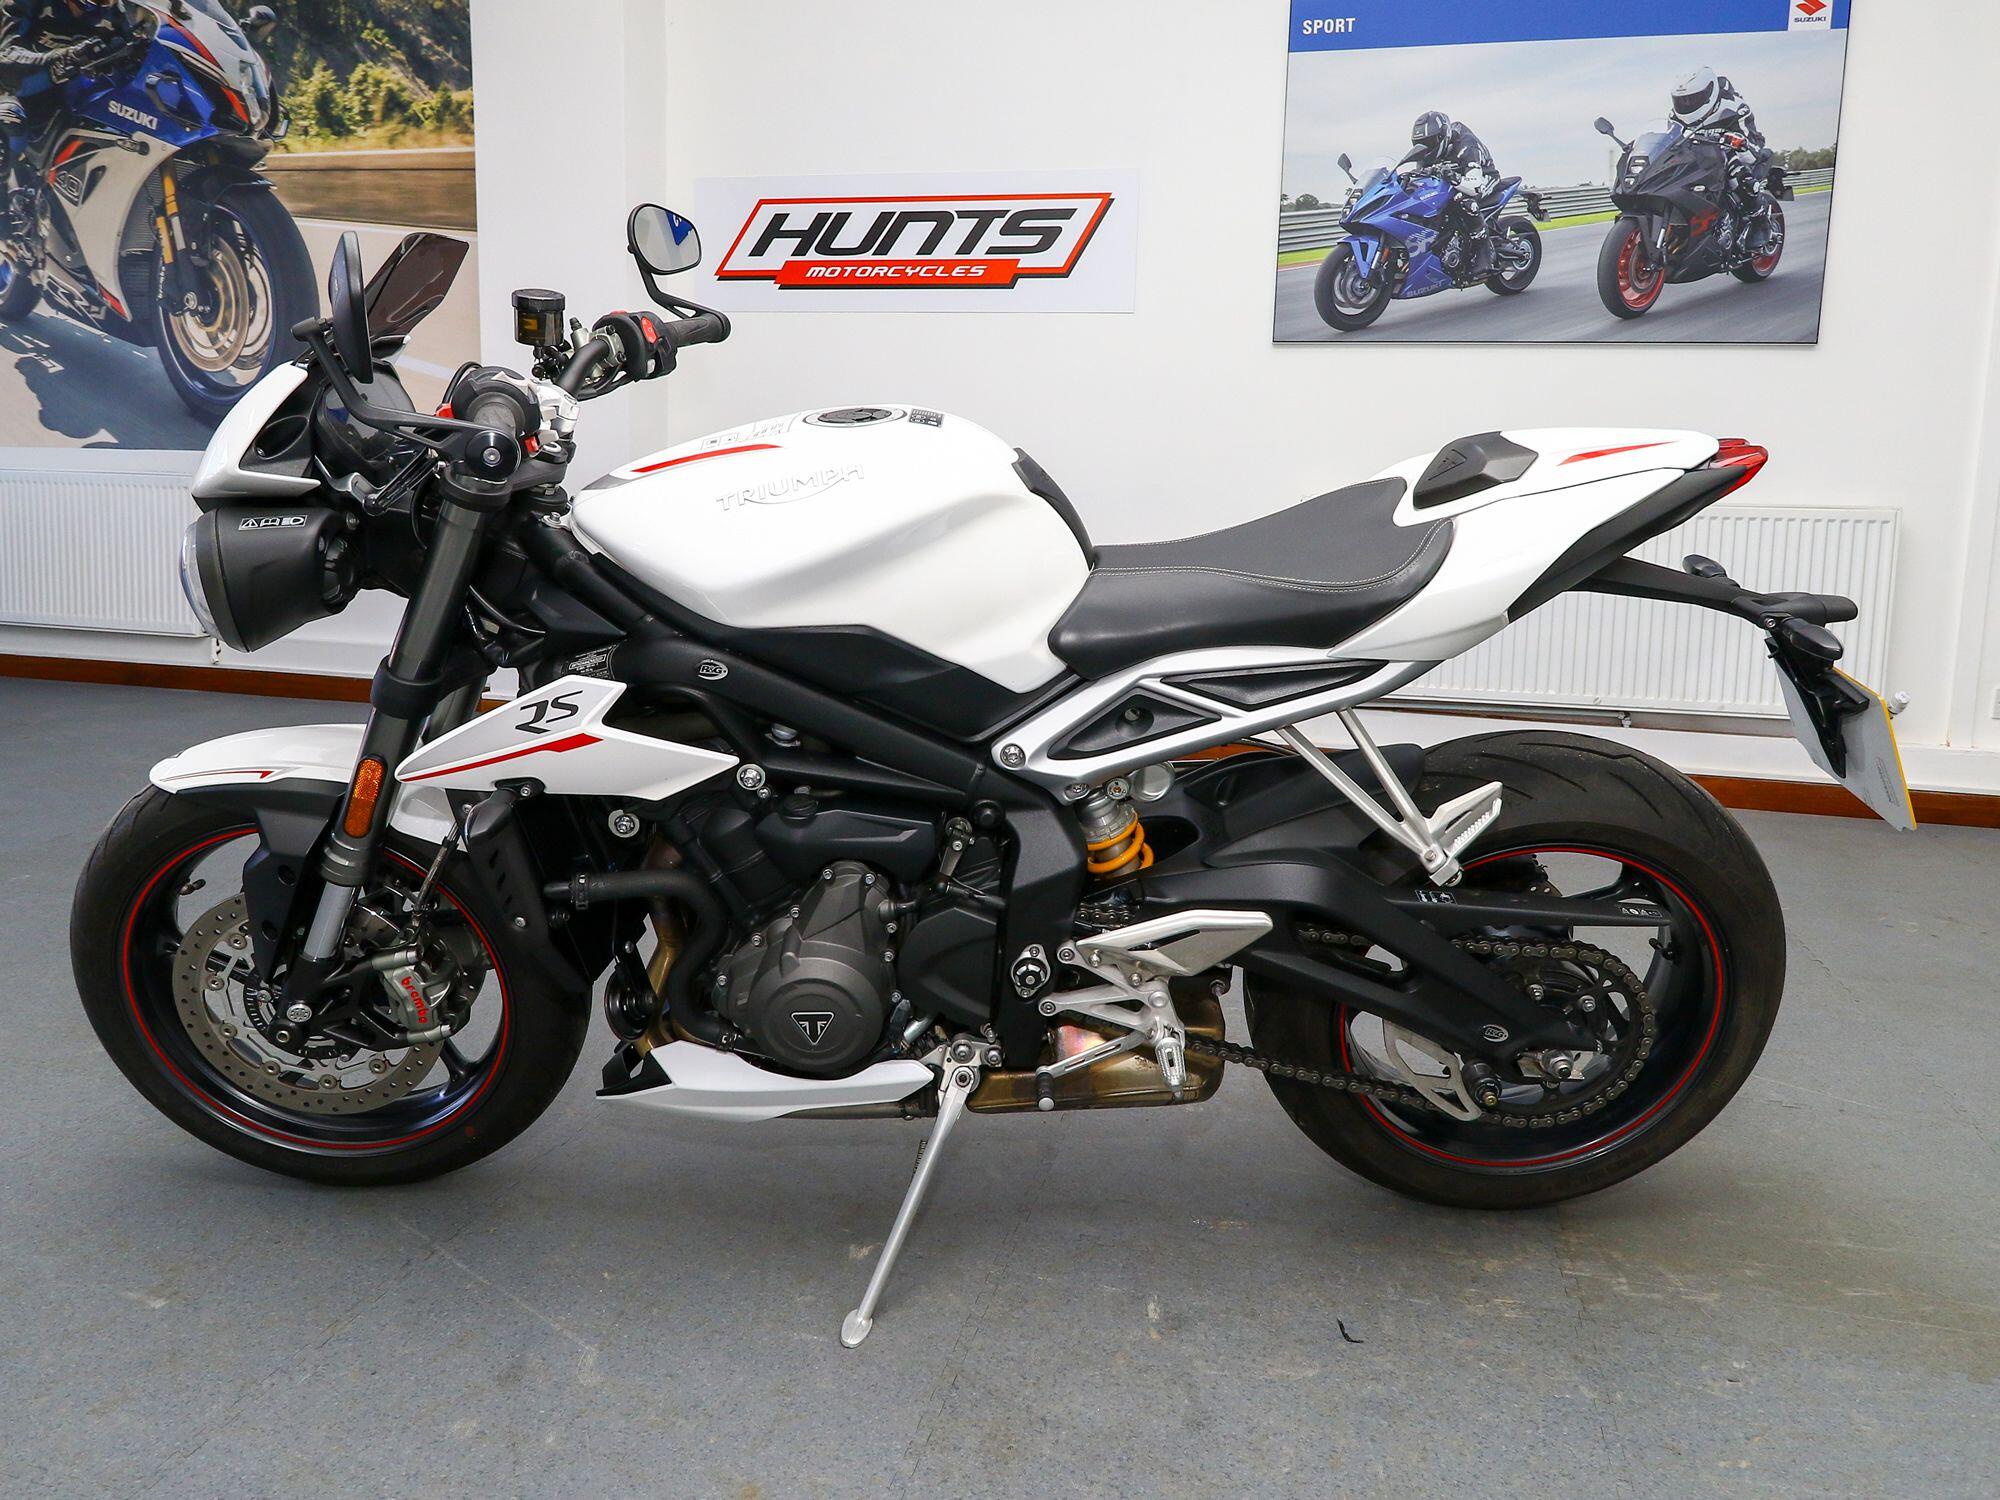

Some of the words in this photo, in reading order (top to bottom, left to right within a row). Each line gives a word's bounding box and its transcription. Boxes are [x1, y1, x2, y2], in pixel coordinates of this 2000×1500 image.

[1302, 17, 1356, 35] SPORT
[108, 99, 158, 130] SUZUKI
[749, 208, 1078, 257] HUNTS
[805, 265, 988, 278] MOTORCYCLES
[716, 464, 864, 511] TRIUMPH
[401, 976, 429, 1025] brembo
